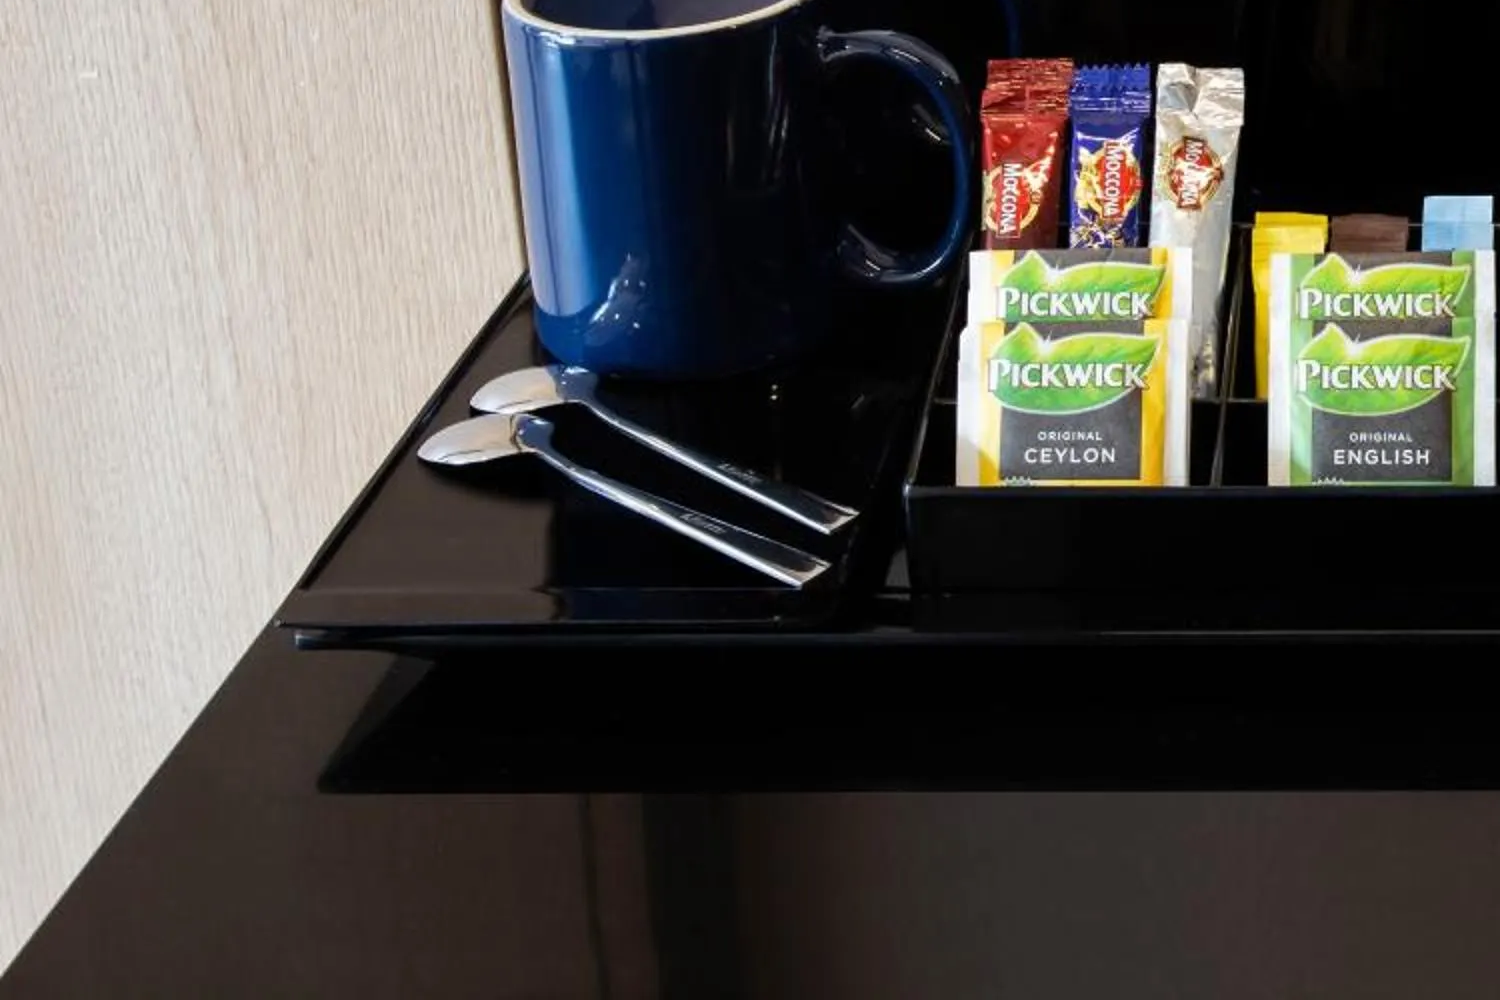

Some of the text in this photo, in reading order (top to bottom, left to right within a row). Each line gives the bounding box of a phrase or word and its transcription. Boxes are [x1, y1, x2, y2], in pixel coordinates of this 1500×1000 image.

[998, 287, 1153, 319] PICKWICK
[1298, 287, 1456, 319] PICKWICK
[988, 358, 1149, 392] PICKWICK
[1296, 359, 1456, 391] PICKWICK
[1037, 430, 1103, 442] ORIGINAL
[1349, 431, 1414, 443] ORIGINAL
[1024, 447, 1116, 464] CEYLON
[1333, 449, 1430, 465] ENGLISH
